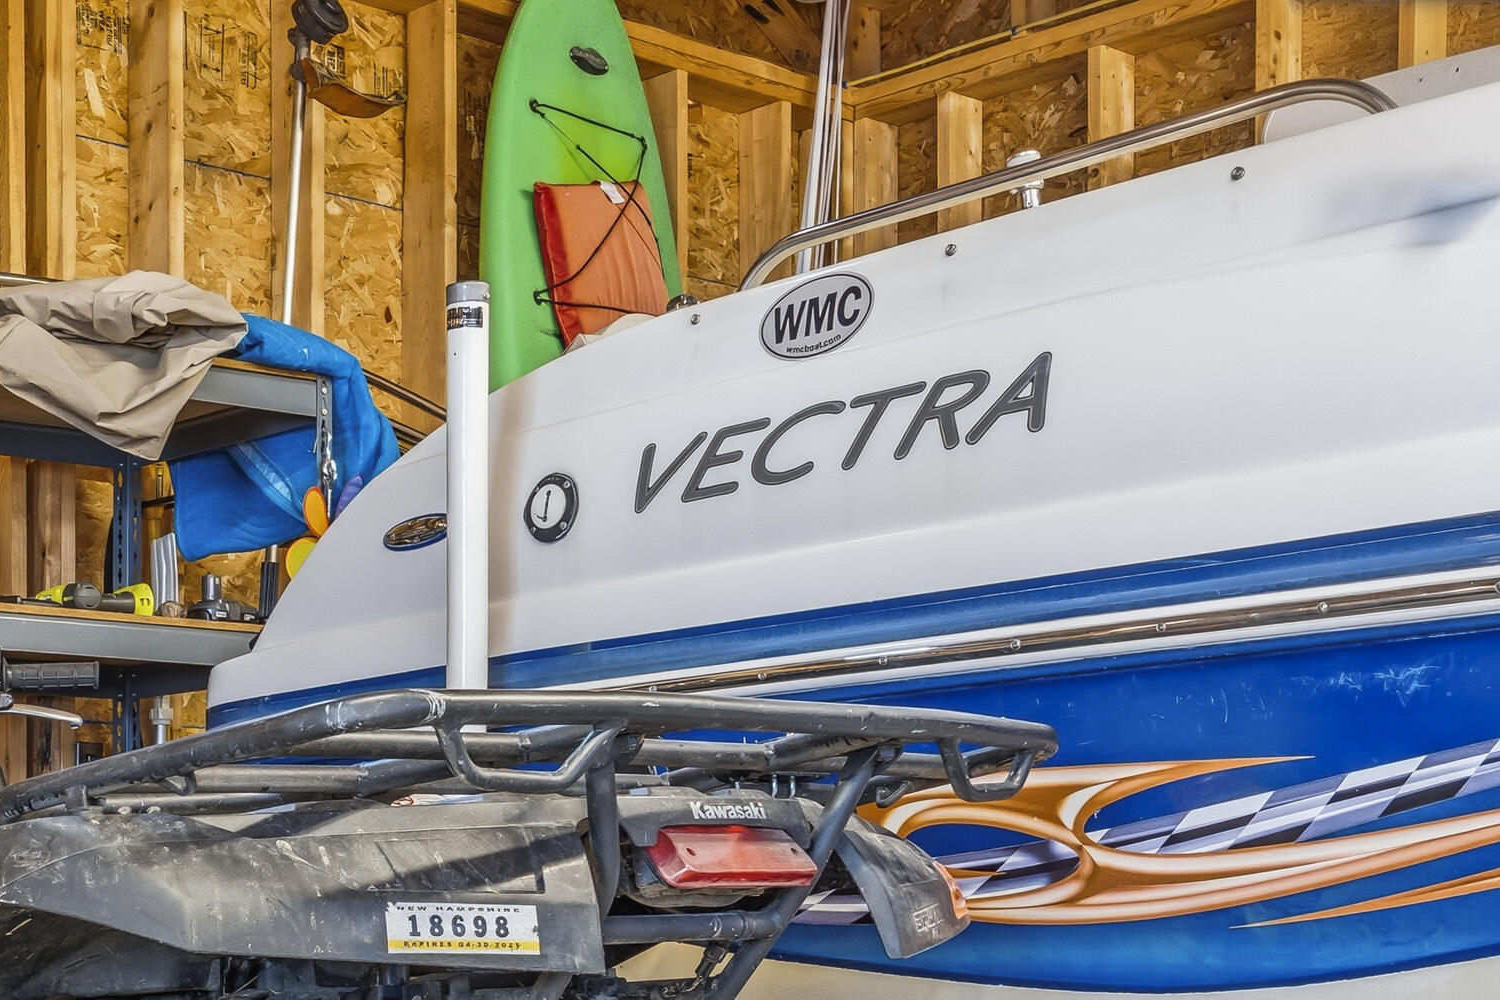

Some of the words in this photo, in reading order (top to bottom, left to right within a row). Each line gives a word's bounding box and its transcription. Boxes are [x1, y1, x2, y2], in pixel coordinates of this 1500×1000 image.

[774, 285, 862, 345] WMC
[786, 334, 842, 354] wmcboat.com
[633, 351, 1053, 514] VECTRA
[689, 801, 767, 820] Kawasaki
[435, 905, 521, 914] HAMPSHIRE
[407, 913, 511, 938] 18698
[403, 940, 453, 949] EXPIRES
